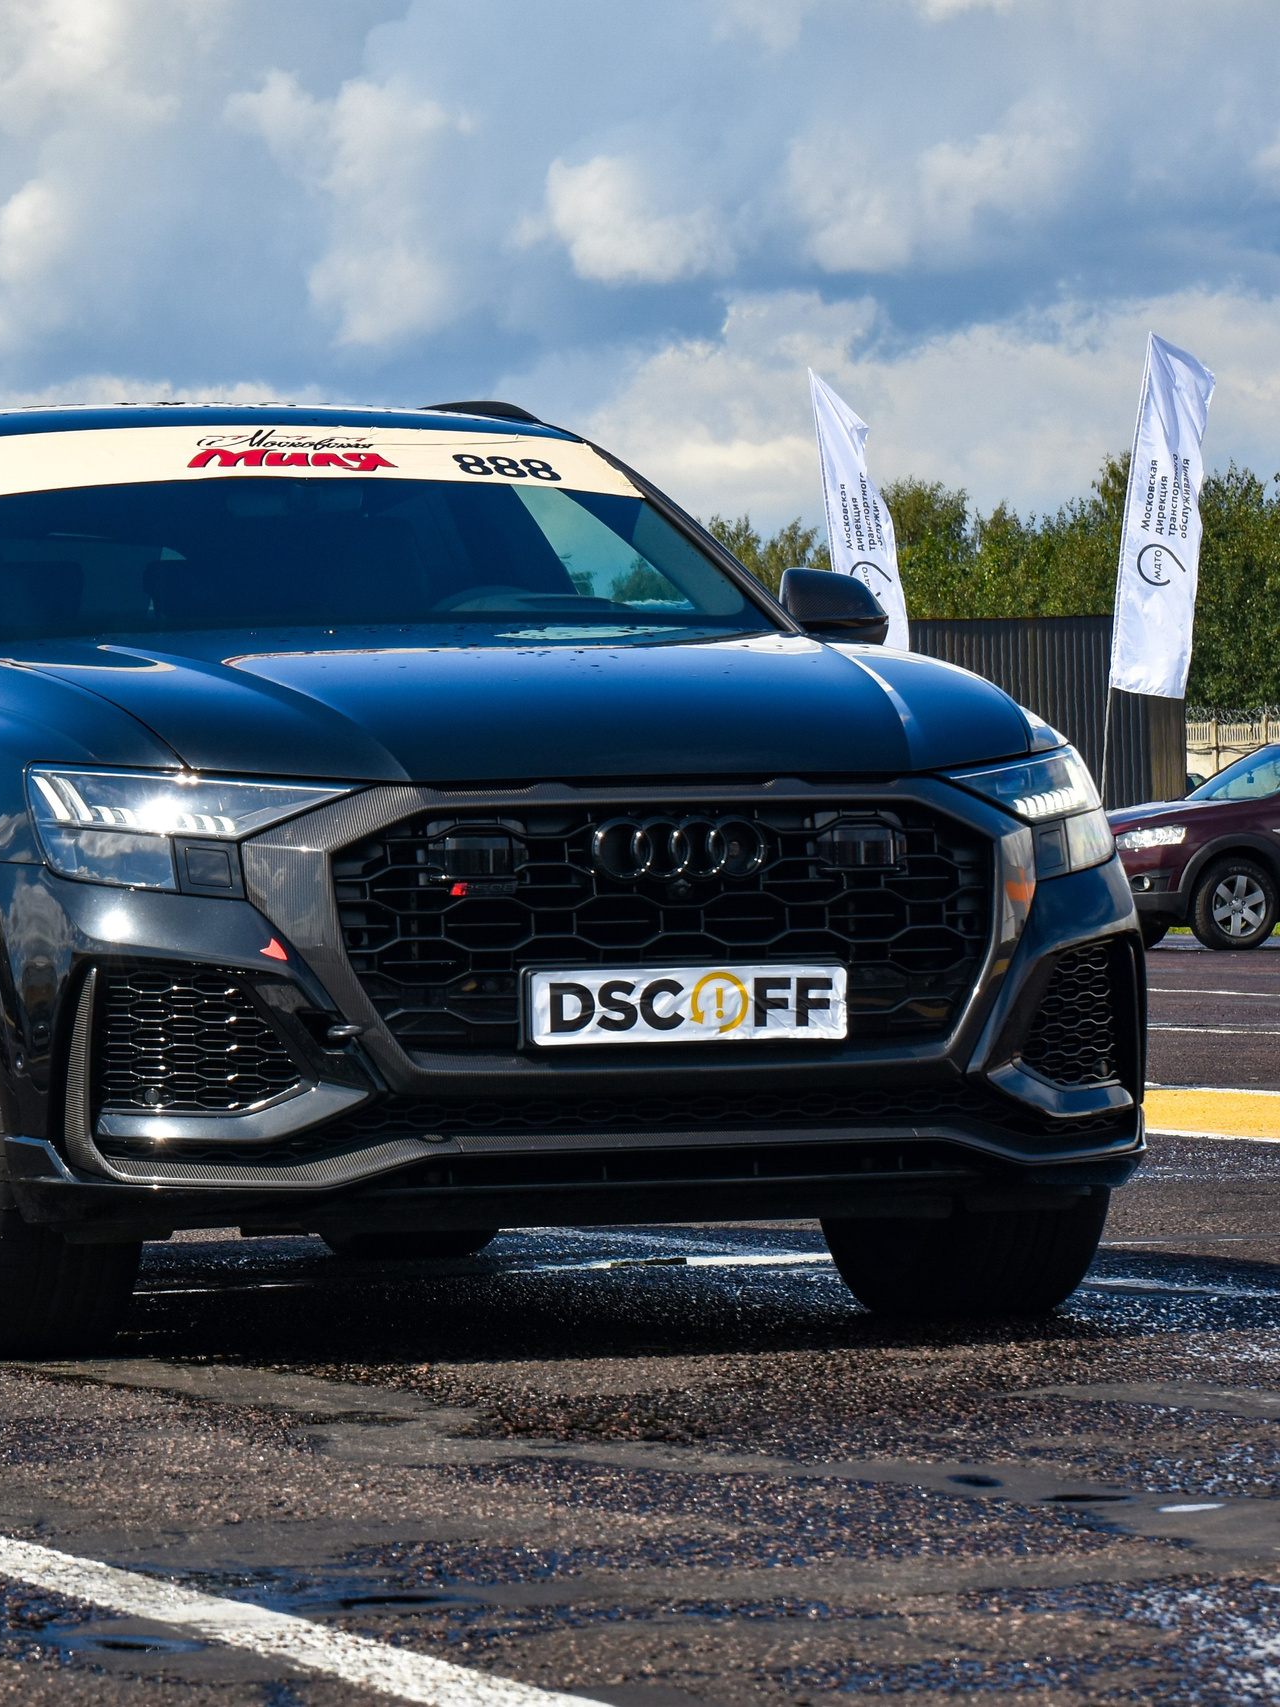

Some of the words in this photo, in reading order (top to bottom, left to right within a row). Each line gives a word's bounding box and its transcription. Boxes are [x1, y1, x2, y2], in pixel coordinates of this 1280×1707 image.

[186, 448, 400, 472] Миля
[451, 453, 563, 481] 888
[1140, 459, 1159, 532] Московская
[1155, 475, 1169, 536] дирекция
[851, 497, 866, 551] дирекция
